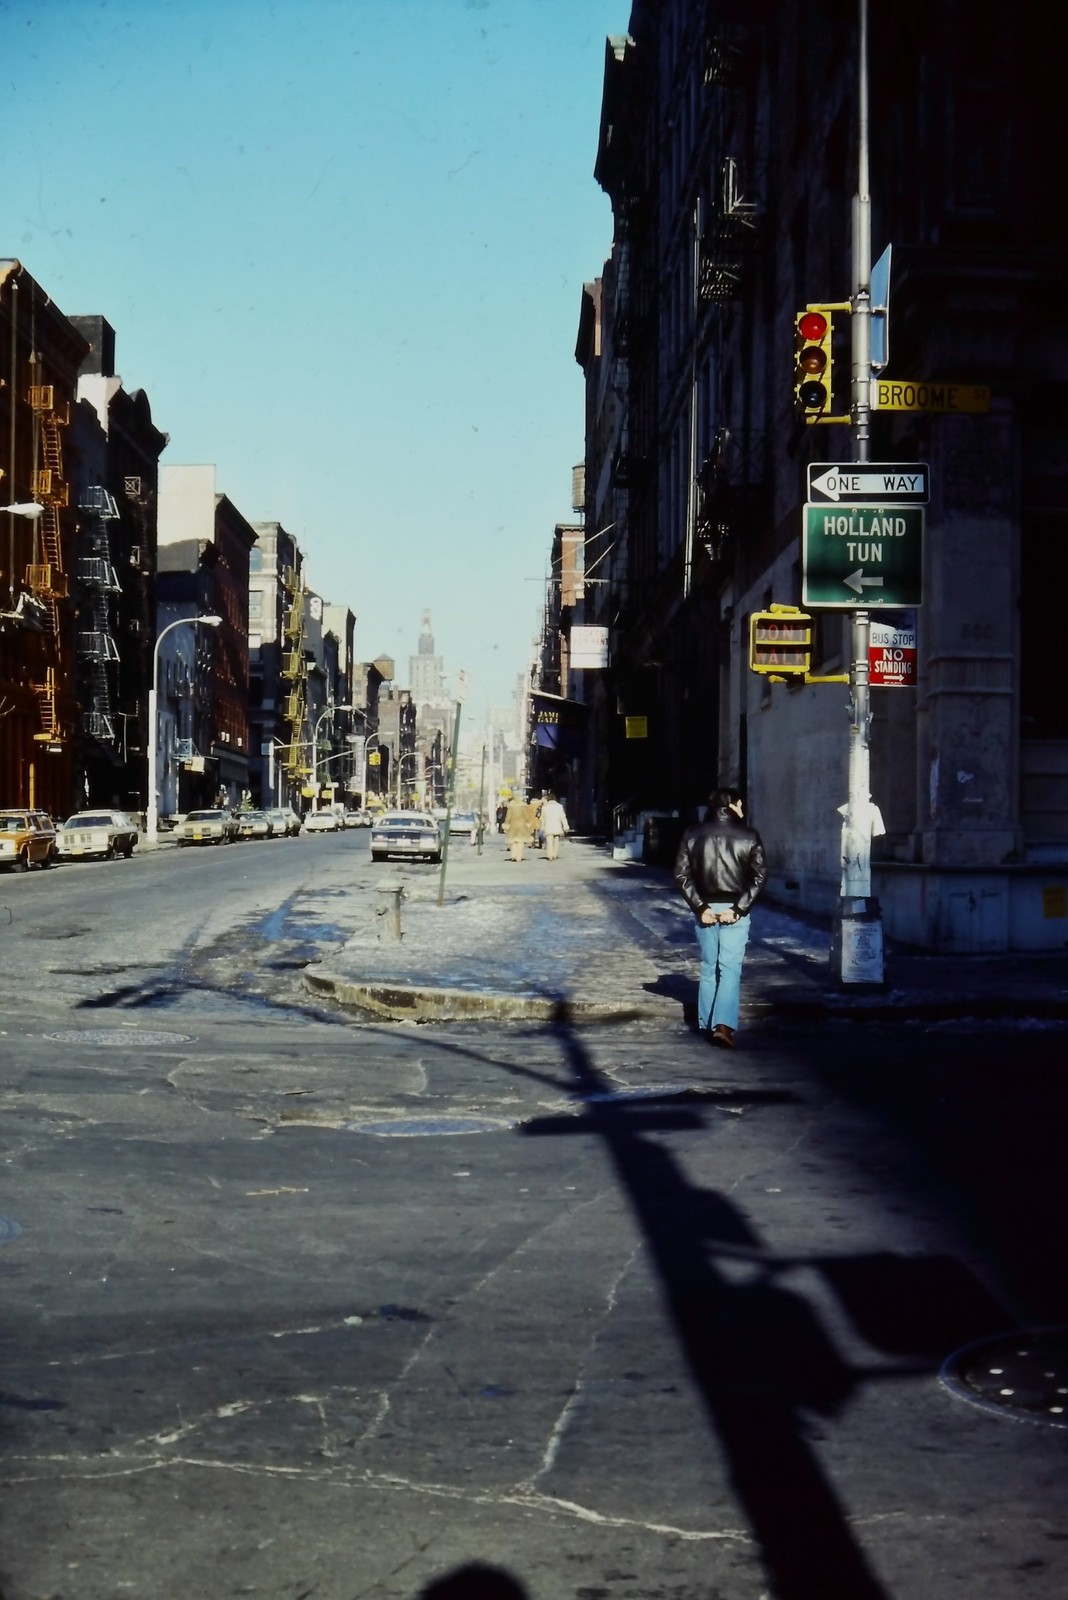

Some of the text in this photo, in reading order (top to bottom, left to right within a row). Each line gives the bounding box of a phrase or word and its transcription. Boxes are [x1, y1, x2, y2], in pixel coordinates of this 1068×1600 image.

[878, 384, 987, 409] BROOME ST
[826, 476, 919, 491] ONE WAY
[823, 516, 906, 537] HOLLAND
[846, 542, 883, 562] TUN
[872, 632, 915, 646] BUS STOP
[882, 649, 904, 661] NO
[874, 661, 913, 674] STANDING
